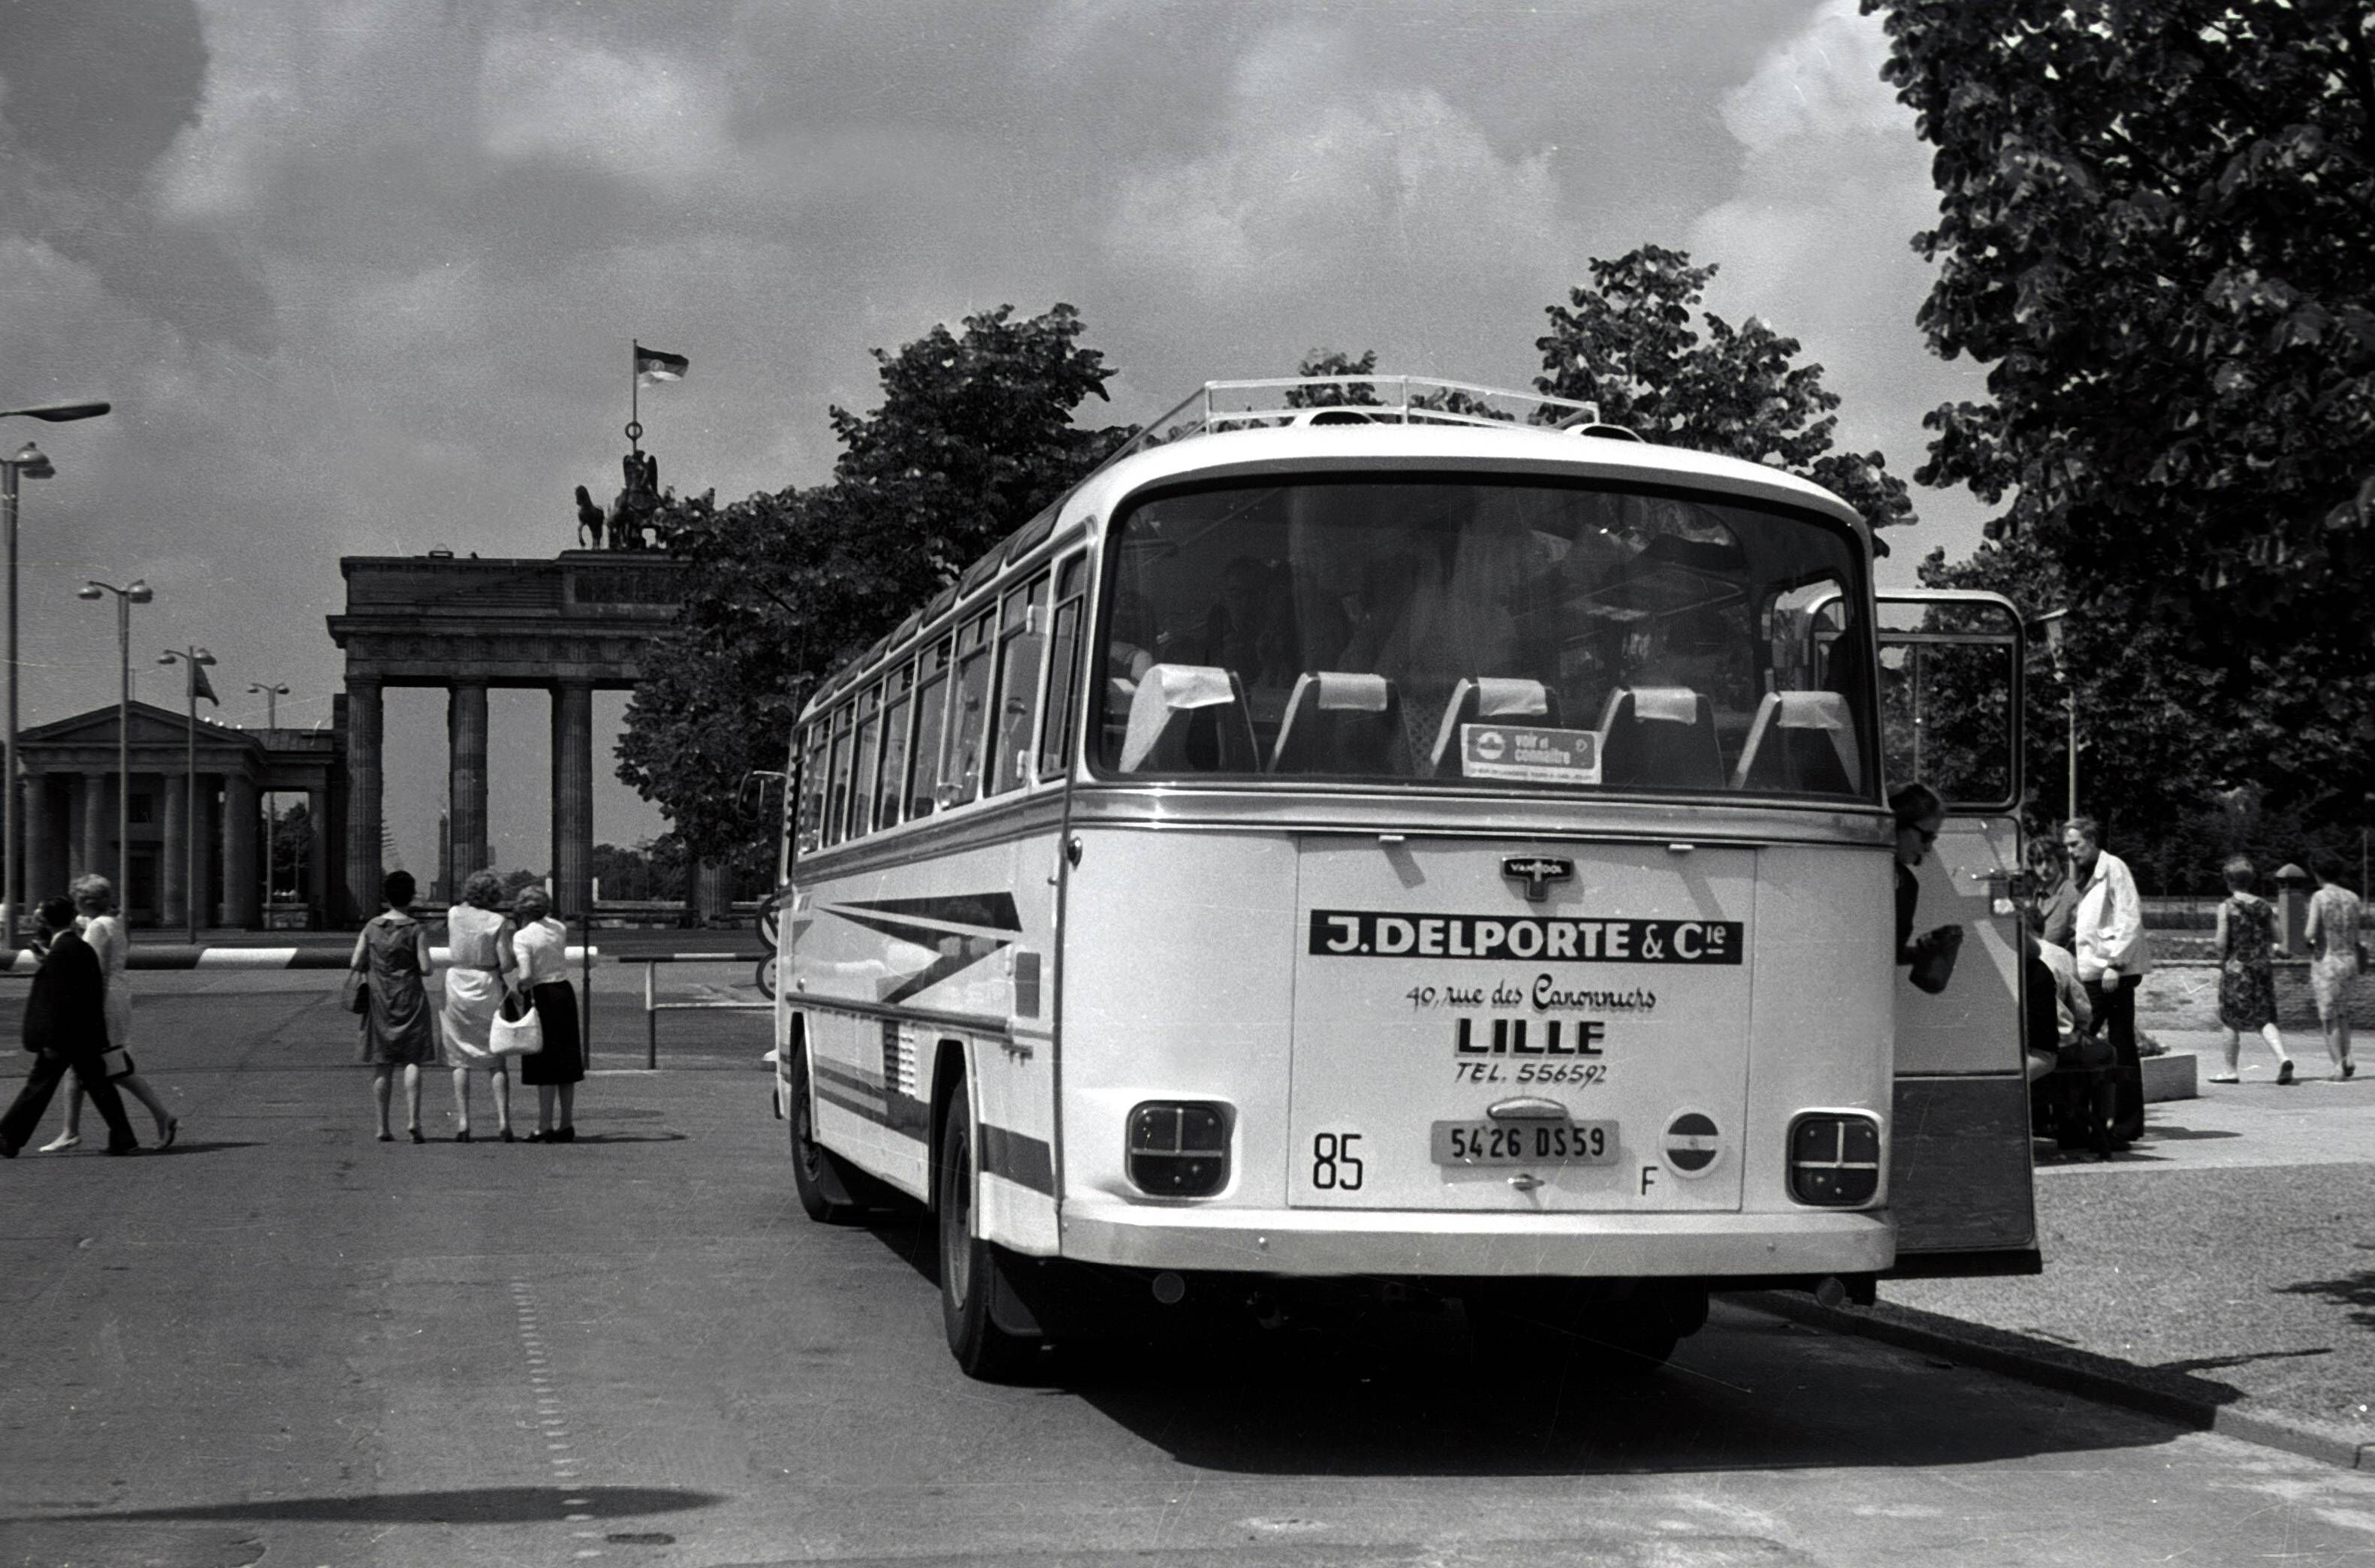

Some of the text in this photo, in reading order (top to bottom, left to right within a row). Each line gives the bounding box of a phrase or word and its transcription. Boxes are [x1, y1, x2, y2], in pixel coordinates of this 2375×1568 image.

[1326, 915, 1631, 957] J.DELPORTE
[1641, 924, 1664, 959] &
[1442, 985, 1484, 1008] rue
[1492, 978, 1523, 1008] des
[1532, 973, 1657, 1012] Canonniers
[1456, 1018, 1605, 1057] LILLE
[1455, 1062, 1607, 1089] TEL. 556592
[1313, 1132, 1363, 1190] 85
[1451, 1128, 1522, 1157] 5426
[1641, 1166, 1658, 1196] F
